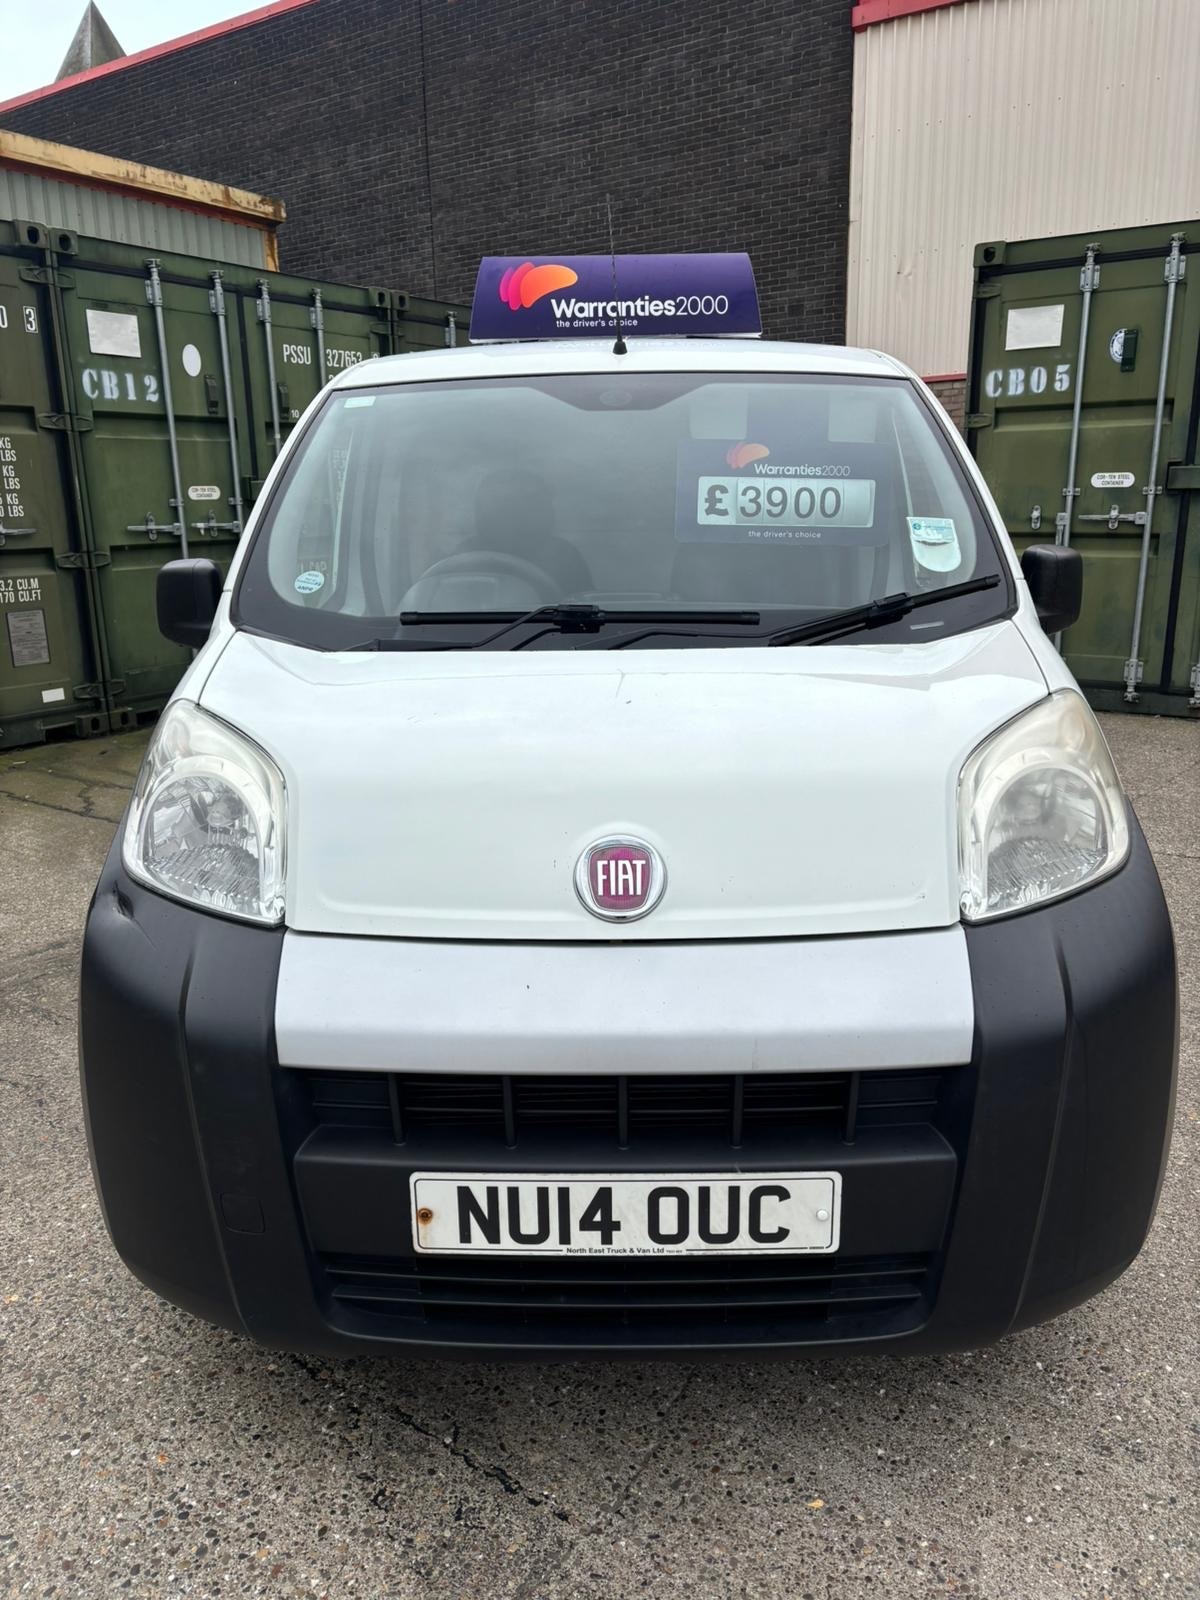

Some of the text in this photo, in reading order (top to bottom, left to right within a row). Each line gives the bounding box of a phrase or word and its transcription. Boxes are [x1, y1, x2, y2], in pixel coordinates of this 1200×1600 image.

[550, 295, 729, 318] Warranties2000
[25, 308, 36, 331] 3
[556, 320, 570, 328] the
[573, 319, 606, 328] driver's
[282, 344, 312, 365] PSSU
[81, 368, 160, 402] CB12
[985, 364, 1071, 398] CB05
[0, 436, 12, 449] KG
[0, 449, 17, 462] LBS
[2, 465, 15, 477] KG
[754, 463, 851, 477] Warranties2000
[4, 477, 21, 490] LBS
[6, 492, 19, 505] KG
[8, 505, 25, 518] LBS
[748, 530, 822, 539] the driver's choice
[16, 577, 40, 590] CU.M
[18, 589, 42, 603] CU.FT
[597, 859, 646, 896] FIAT
[456, 1184, 791, 1246] NU14 OUC
[652, 1246, 665, 1254] Ltd
